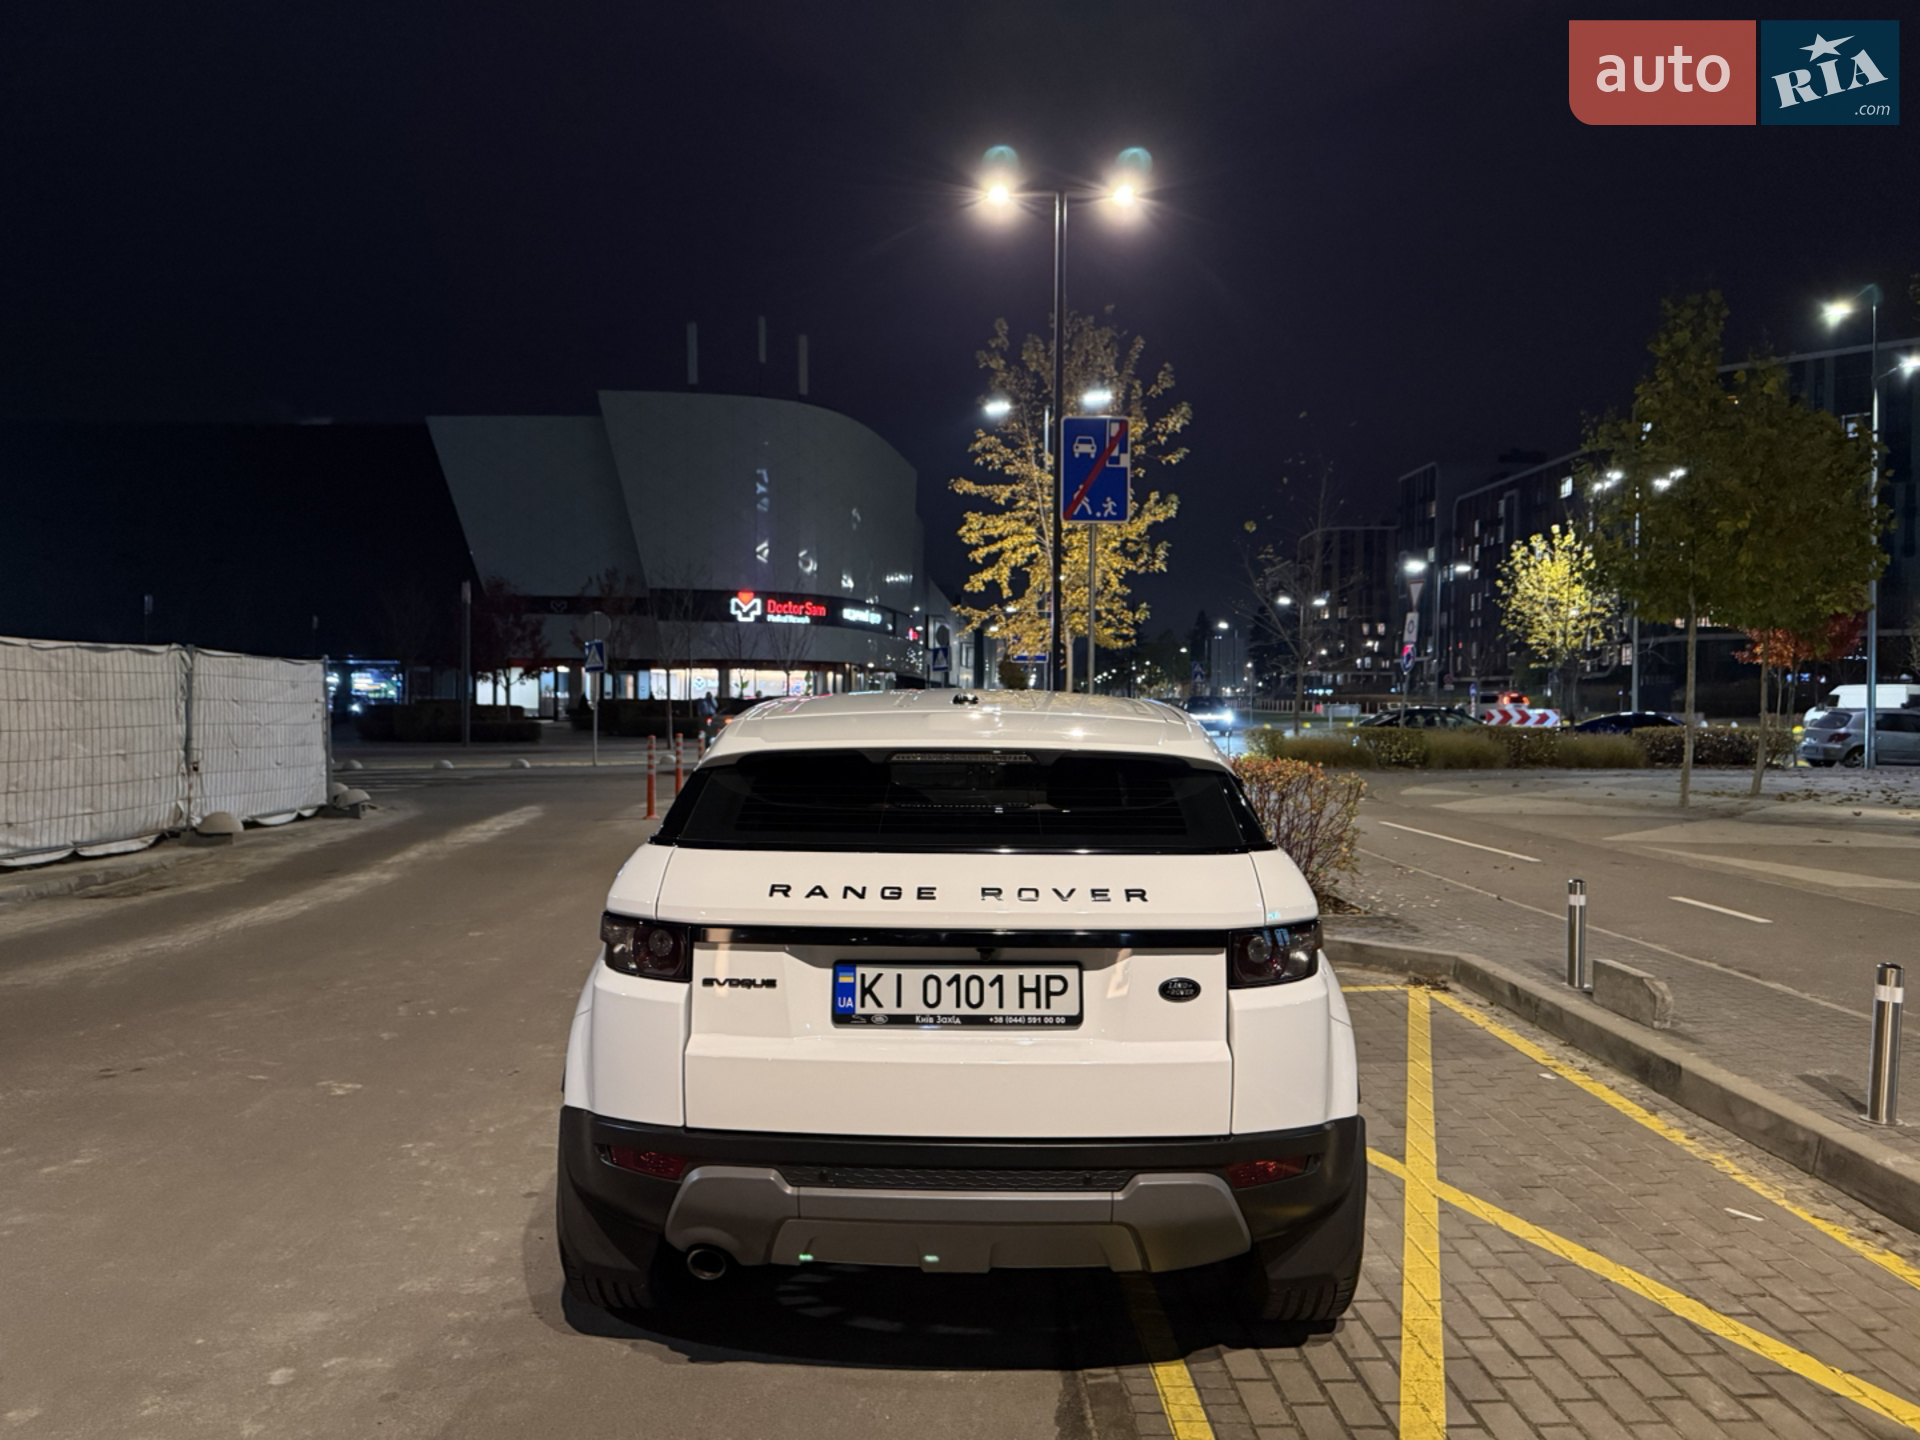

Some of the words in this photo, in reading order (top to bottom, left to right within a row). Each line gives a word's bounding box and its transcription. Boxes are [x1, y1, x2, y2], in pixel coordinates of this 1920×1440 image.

[766, 598, 804, 615] Doctor
[805, 600, 827, 617] Sam
[768, 883, 938, 901] RANGE
[981, 886, 1149, 903] ROVER
[702, 977, 777, 990] EVOQUE
[860, 972, 902, 1009] KI
[922, 973, 1004, 1009] 0101
[1018, 974, 1069, 1010] HP
[838, 996, 854, 1008] UA
